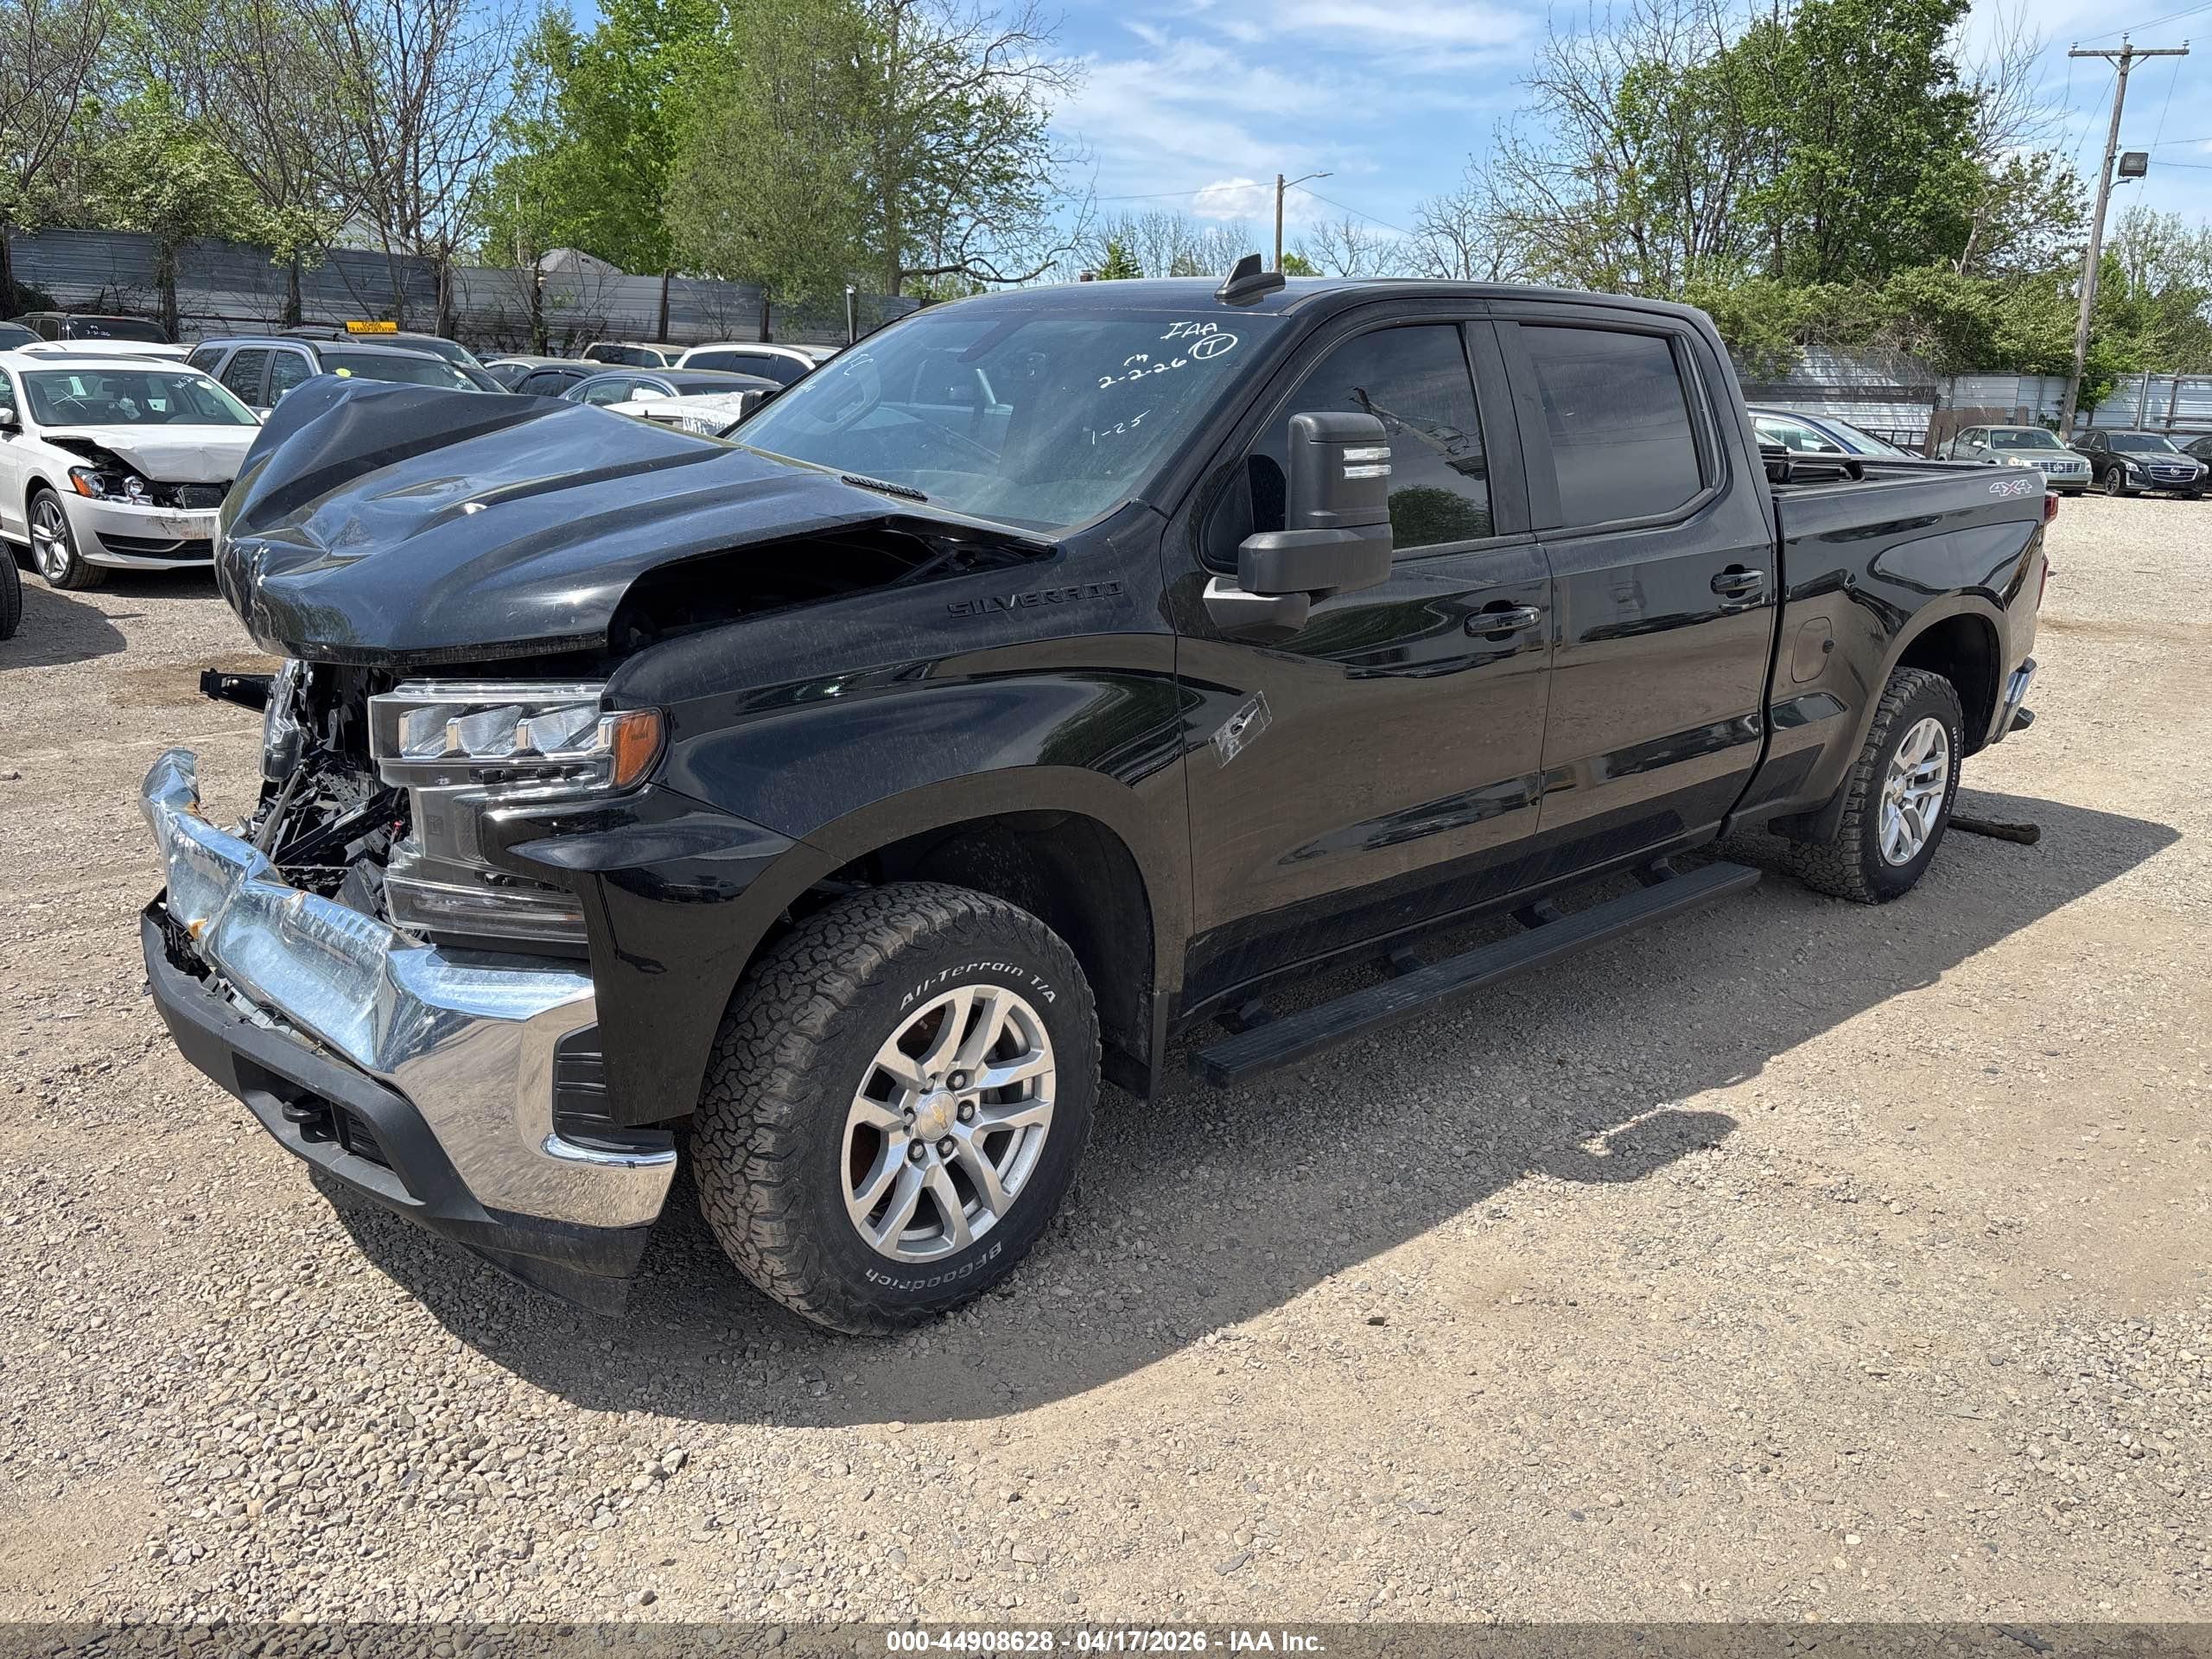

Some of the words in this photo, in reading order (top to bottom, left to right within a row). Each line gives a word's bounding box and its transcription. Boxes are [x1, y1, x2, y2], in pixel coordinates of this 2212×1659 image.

[1160, 321, 1217, 340] IAA
[1098, 358, 1187, 389] 2-2-26
[948, 580, 1122, 618] SILVERADO
[899, 961, 1025, 1012] All-Terrain
[1030, 973, 1056, 1005] T/A
[865, 1240, 1003, 1294] BFGoodrich
